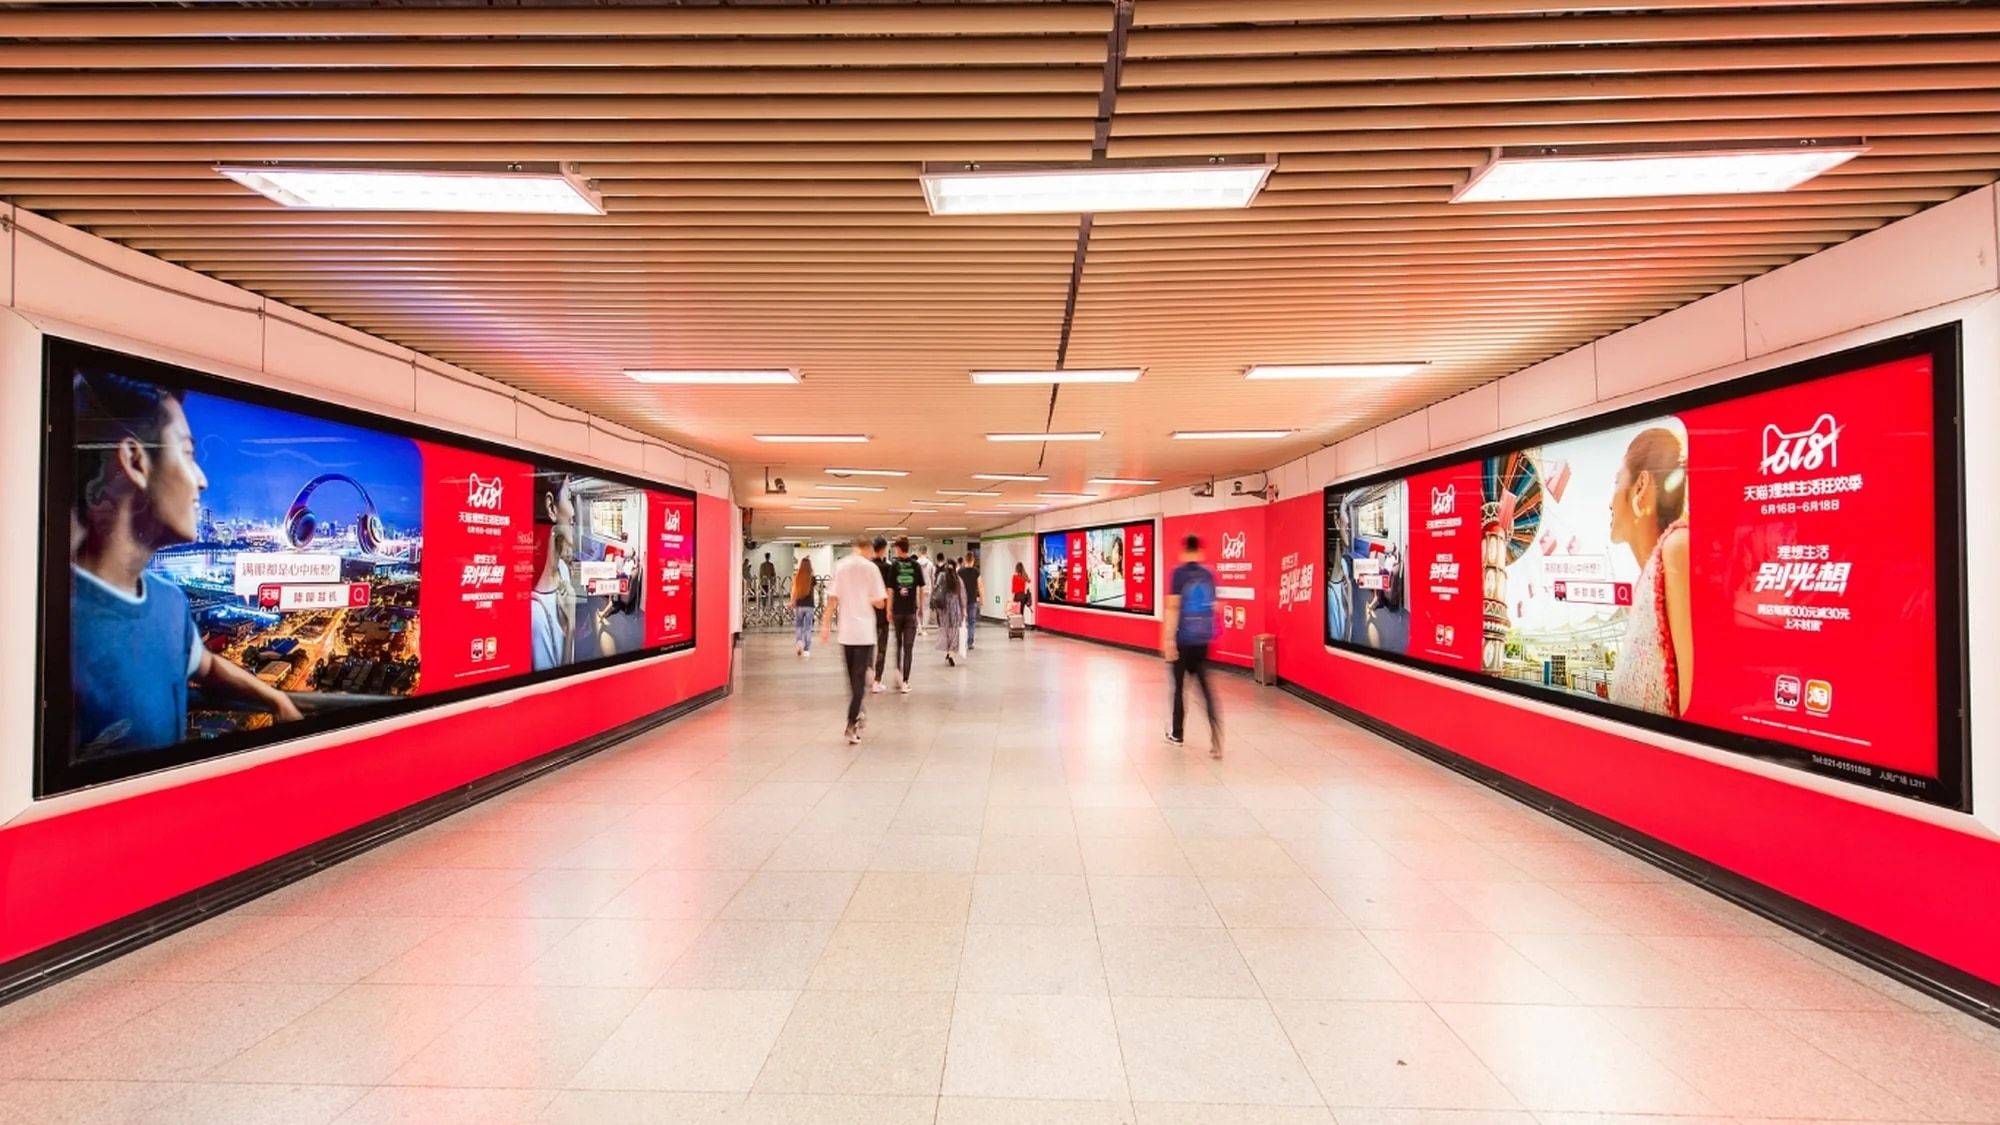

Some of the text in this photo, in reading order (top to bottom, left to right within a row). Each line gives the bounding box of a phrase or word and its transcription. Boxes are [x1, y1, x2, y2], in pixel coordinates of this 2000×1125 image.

[1743, 474, 1863, 502] 天猫理想生活狂欢季
[1760, 499, 1840, 515] 6月16日-6月18日
[1777, 545, 1830, 560] 理想生活
[461, 565, 505, 588] 别光想
[1754, 562, 1852, 598] 别光想
[261, 588, 279, 601] 天猫
[1778, 681, 1798, 695] 天猫
[1807, 686, 1828, 706] 淘
